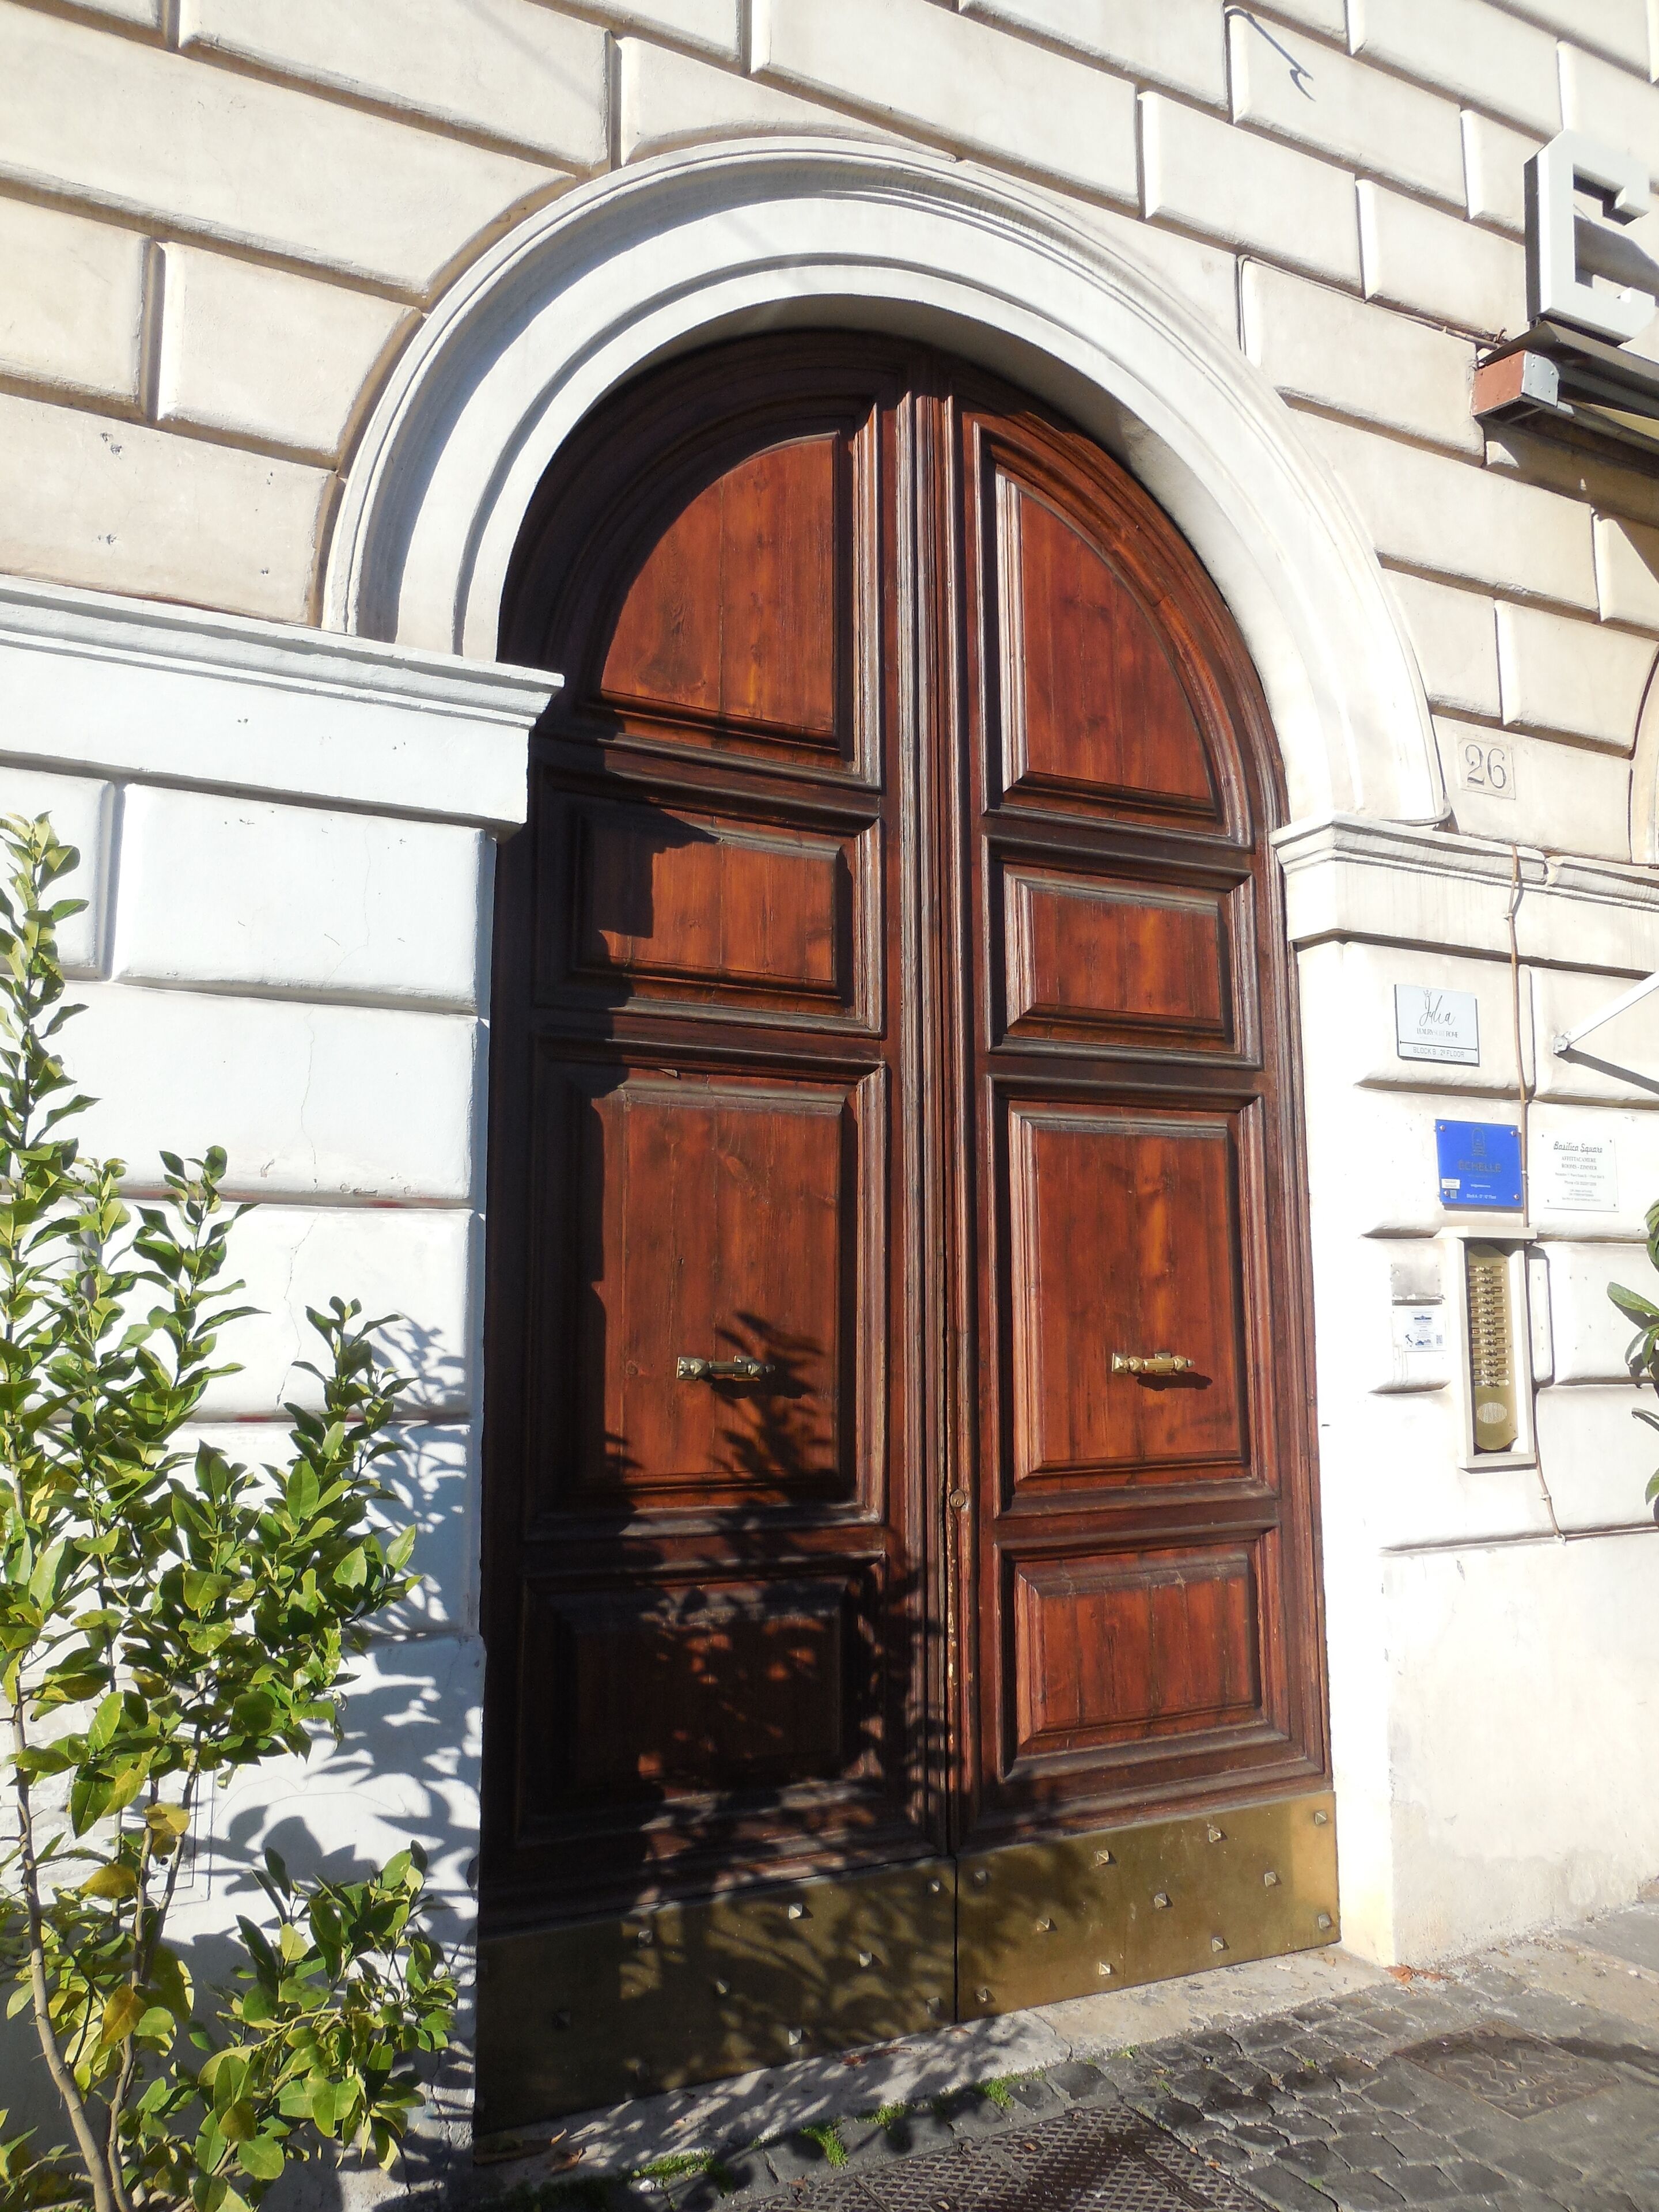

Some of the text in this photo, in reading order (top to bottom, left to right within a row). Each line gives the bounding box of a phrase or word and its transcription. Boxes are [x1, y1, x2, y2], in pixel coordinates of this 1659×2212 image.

[1465, 744, 1507, 789] 26
[1419, 995, 1456, 1027] Julia
[1413, 1046, 1431, 1055] BLOCK
[1446, 1050, 1464, 1058] FLOOR
[1553, 1141, 1603, 1155] Basilica Square
